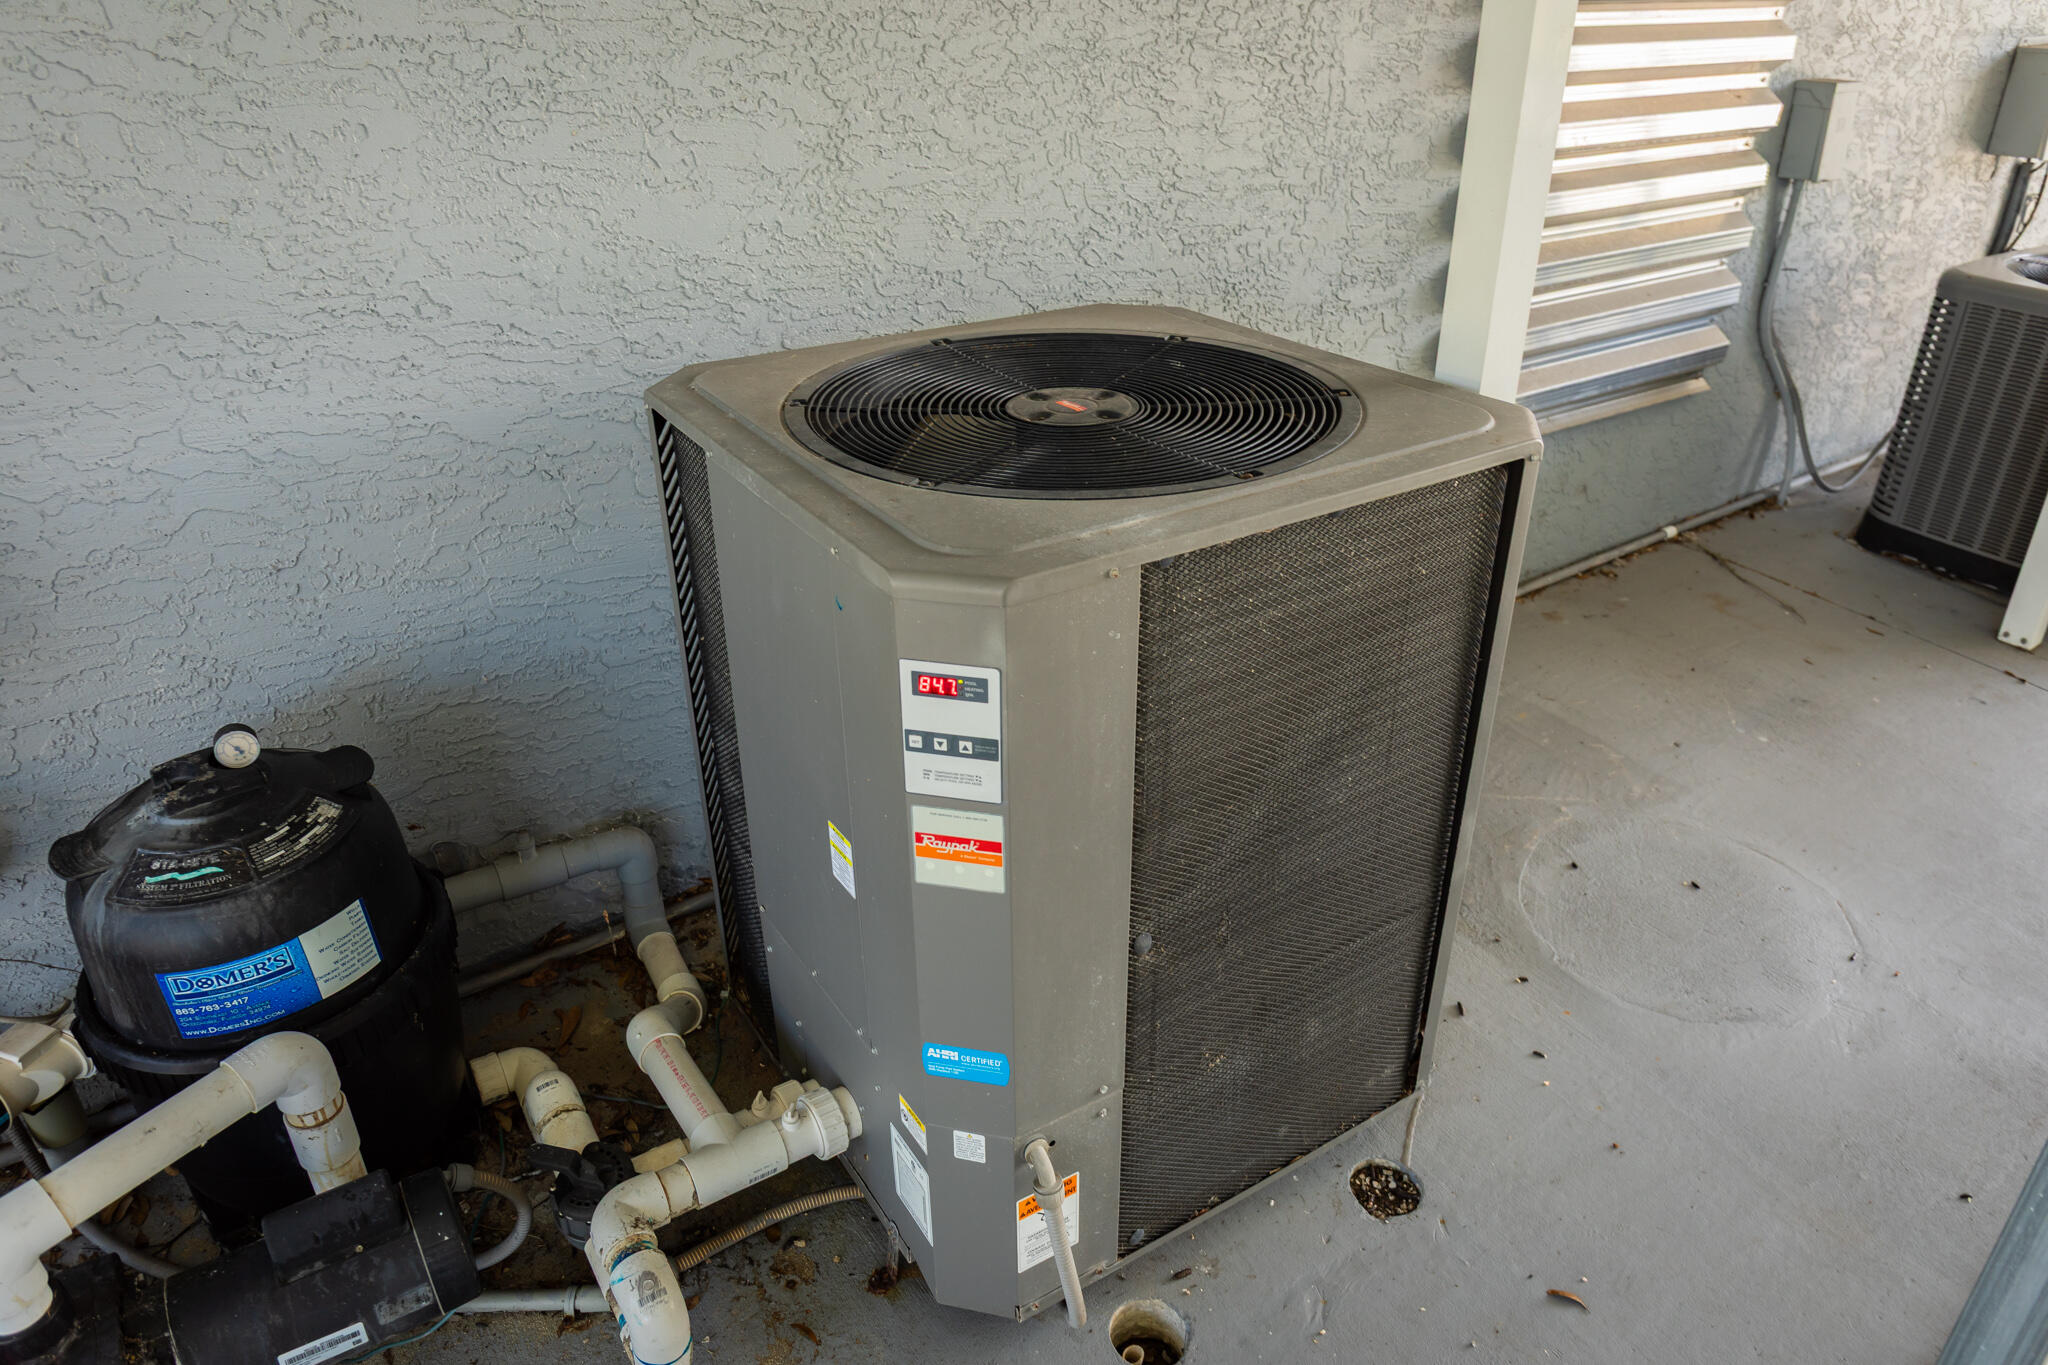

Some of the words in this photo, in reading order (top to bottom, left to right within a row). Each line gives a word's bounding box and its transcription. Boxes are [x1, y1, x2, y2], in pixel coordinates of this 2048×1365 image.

[920, 834, 979, 854] Raypak
[179, 874, 232, 890] FILTRATION
[172, 953, 288, 993] DOMER'S
